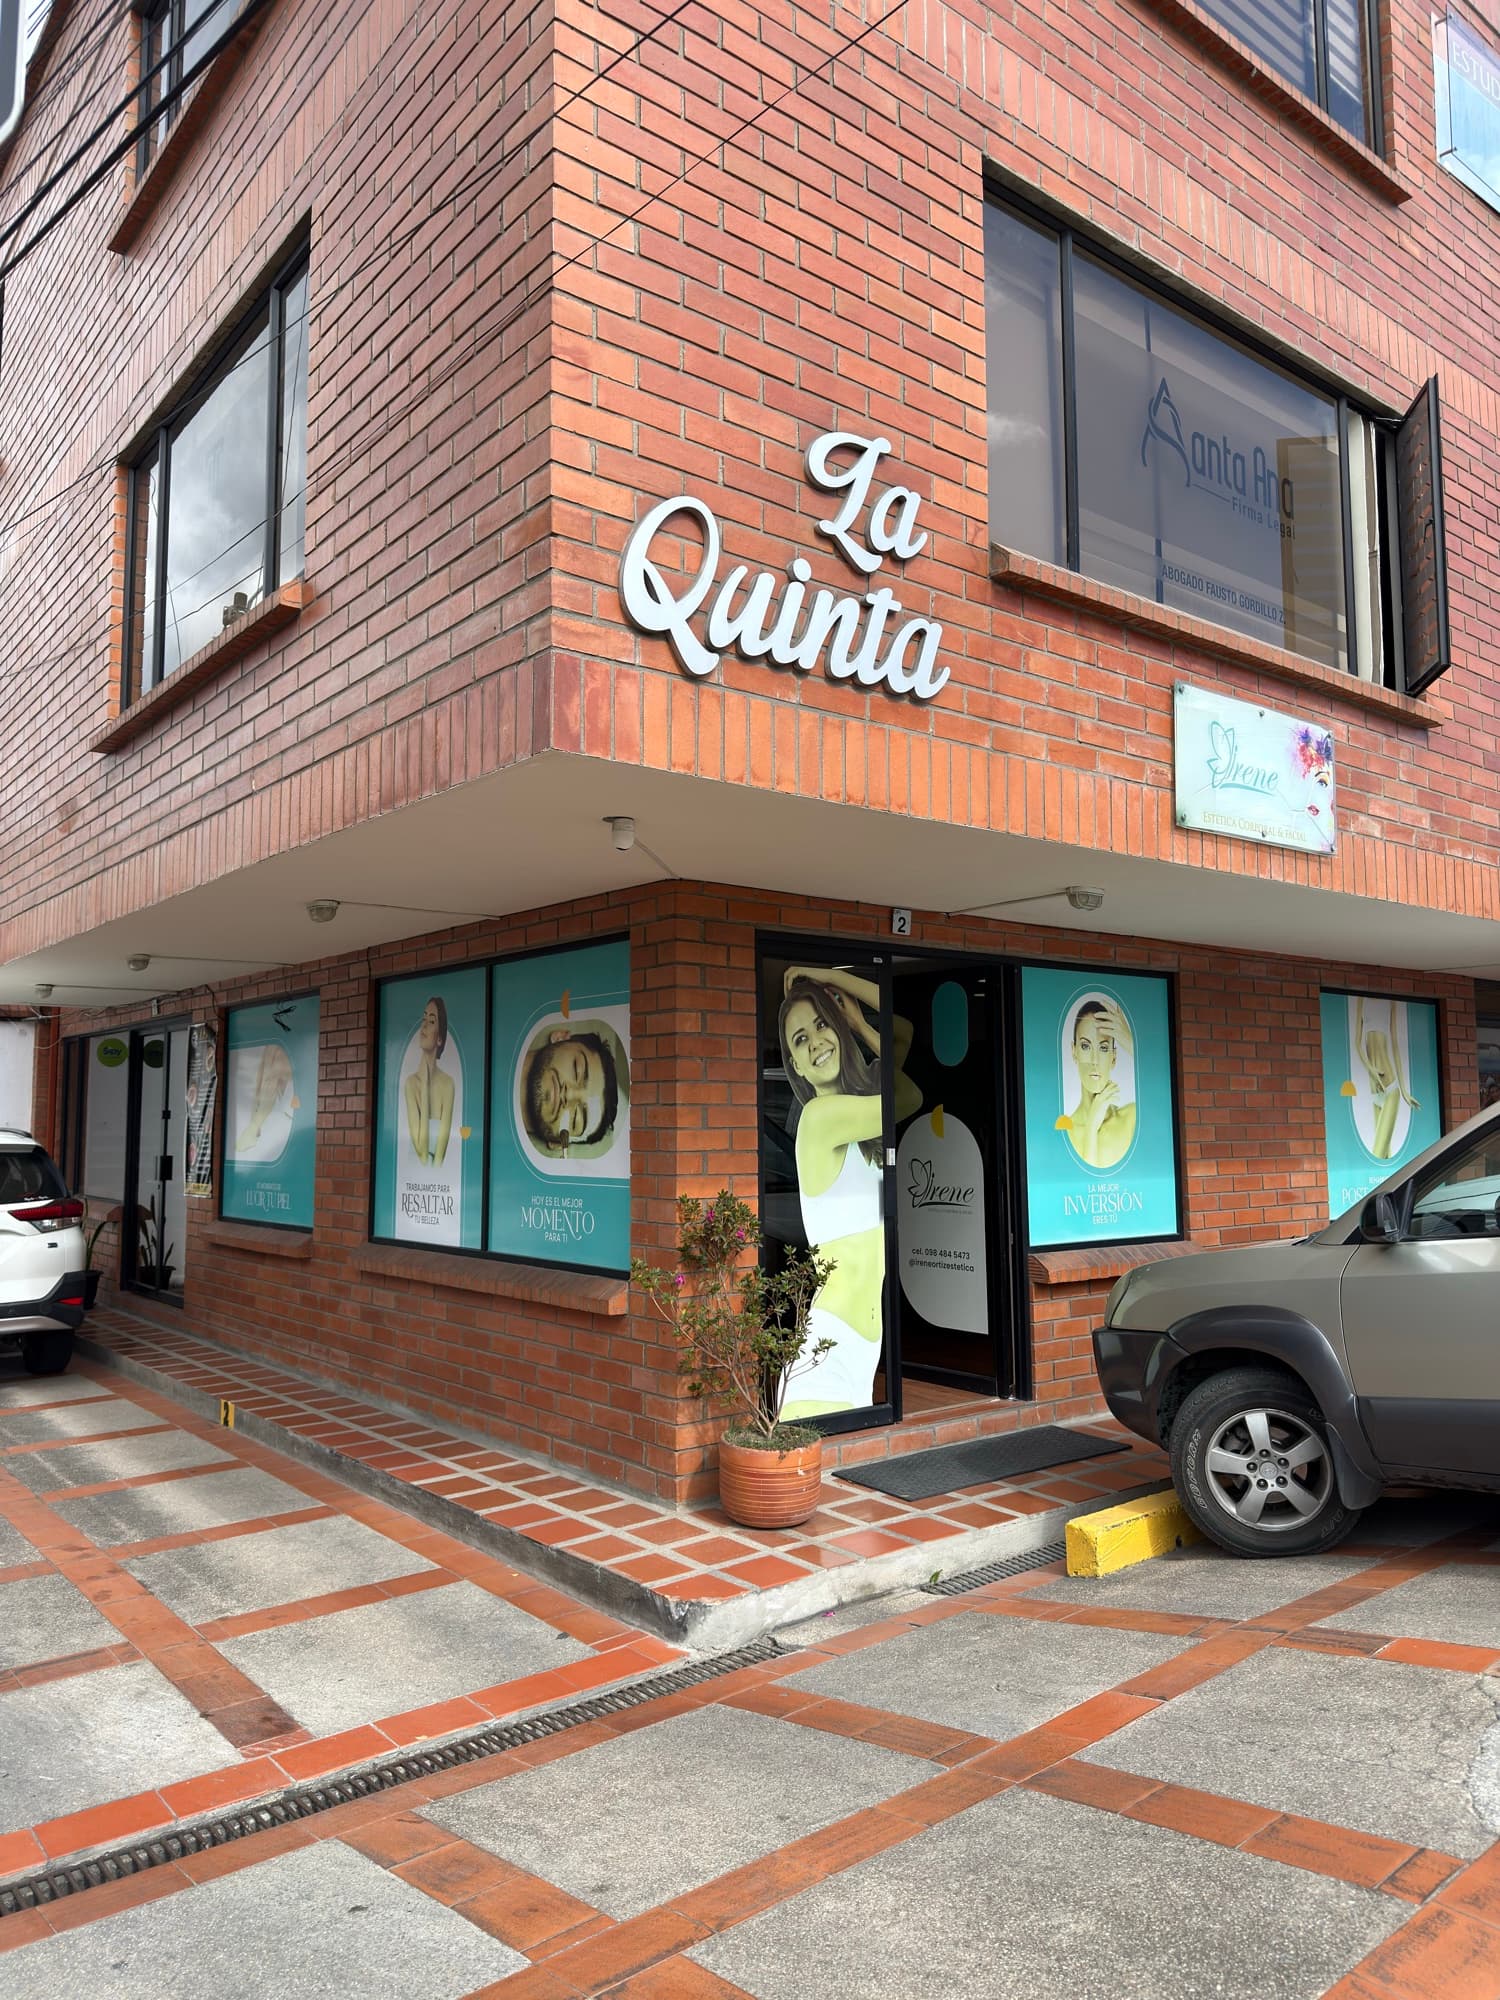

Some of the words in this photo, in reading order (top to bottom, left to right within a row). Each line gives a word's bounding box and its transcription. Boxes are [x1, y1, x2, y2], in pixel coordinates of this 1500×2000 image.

[1253, 446, 1294, 520] Ana
[805, 431, 928, 575] La
[1232, 495, 1263, 524] Firma
[619, 495, 951, 699] Quinta
[1161, 563, 1204, 592] ABOGADO
[1205, 581, 1238, 605] FAUSTO
[1240, 594, 1277, 619] GORDILLO
[897, 916, 906, 934] 2
[437, 1184, 450, 1193] PARA
[1087, 1184, 1096, 1193] LA
[401, 1193, 454, 1218] RESALTAR
[532, 1195, 544, 1205] HOY
[545, 1196, 553, 1206] ES
[554, 1197, 561, 1207] EL
[562, 1198, 583, 1209] MEJOR
[1063, 1188, 1143, 1216] INVERSIÓN
[520, 1206, 595, 1240] MOMENTO
[544, 1232, 560, 1242] PARA
[562, 1233, 568, 1243] TI
[953, 1250, 970, 1260] 5473
[223, 1401, 229, 1427] 2
